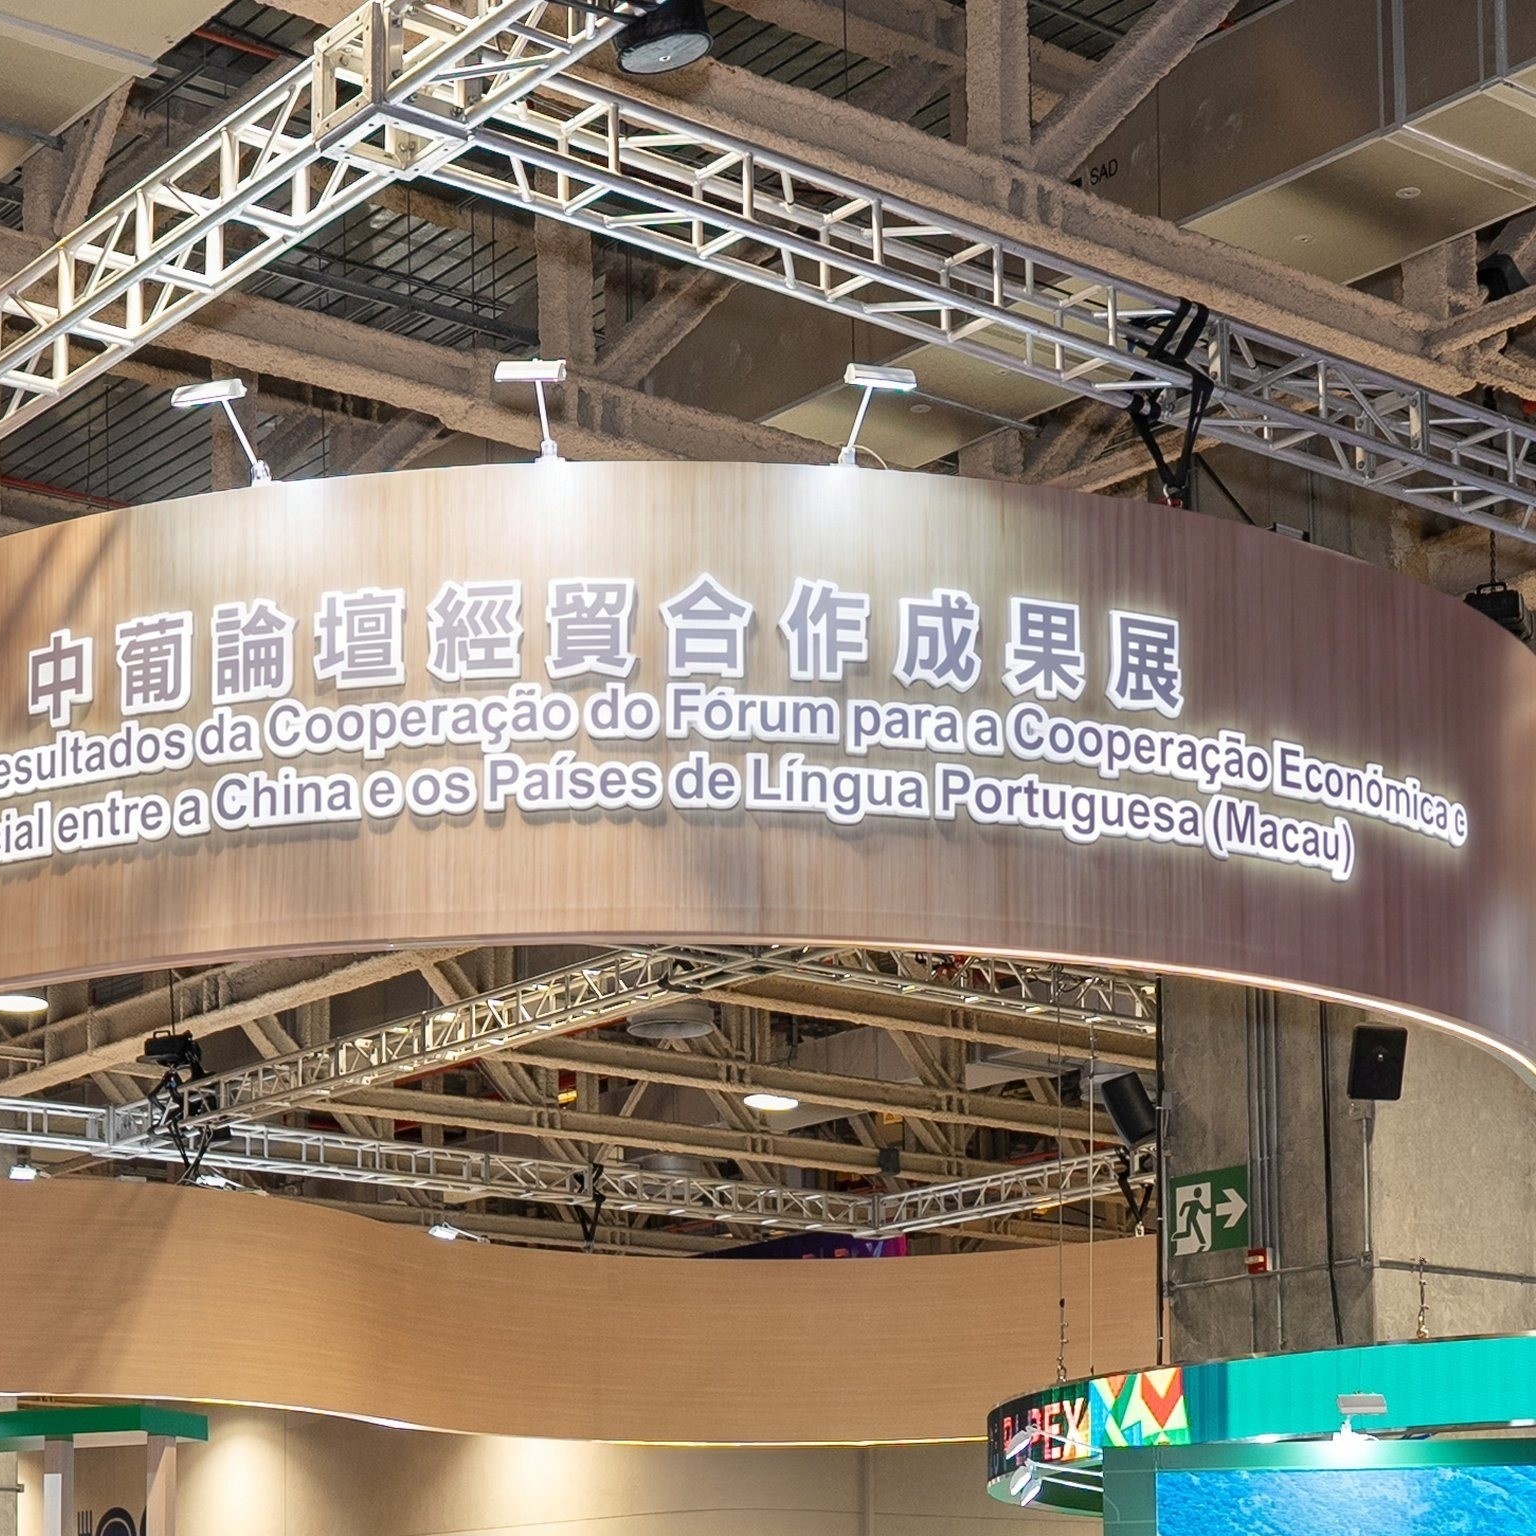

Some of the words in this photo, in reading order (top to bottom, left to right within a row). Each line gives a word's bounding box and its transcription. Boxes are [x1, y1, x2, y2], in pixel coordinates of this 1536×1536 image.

[1090, 158, 1119, 186] SAD
[30, 575, 1182, 721] 中葡論壇經貿合作成果展
[57, 797, 164, 843] entre
[177, 792, 203, 827] a
[215, 768, 352, 819] China
[368, 772, 396, 806] e
[414, 769, 466, 804] os
[490, 757, 659, 804] Países
[674, 757, 735, 799] de
[755, 757, 923, 820] Língua
[942, 768, 1199, 840] Portuguesa
[1211, 803, 1355, 876] (Macau)
[202, 709, 257, 757] da
[268, 686, 572, 754] Cooperação
[590, 687, 655, 738] do
[671, 687, 835, 738] Fórum
[852, 701, 958, 749] para
[974, 711, 998, 749] a
[1015, 707, 1268, 786] Cooperação
[1278, 745, 1449, 832] Económica
